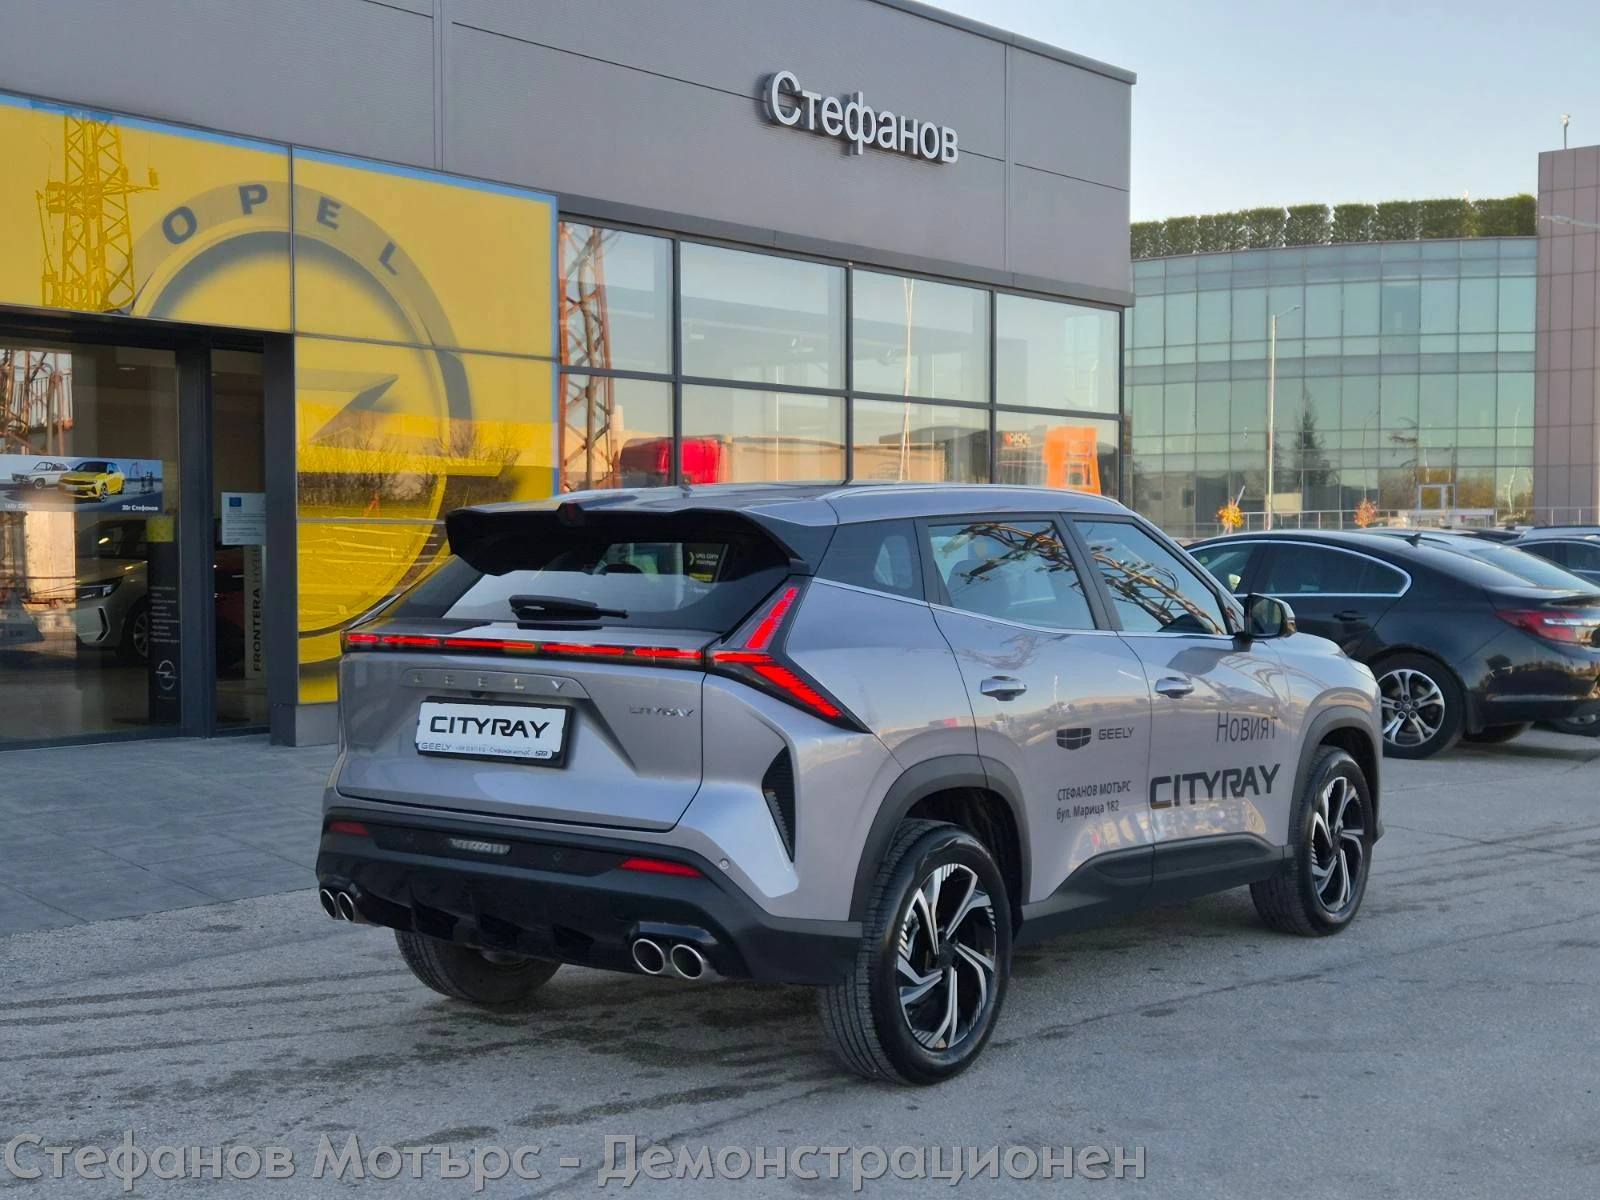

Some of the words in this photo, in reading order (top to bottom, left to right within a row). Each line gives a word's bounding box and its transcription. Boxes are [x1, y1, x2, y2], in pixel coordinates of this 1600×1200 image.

[766, 70, 960, 164] Стефанов
[162, 183, 400, 276] OPEL
[252, 587, 262, 673] FRONTERA
[429, 715, 551, 739] CITYRAY
[1098, 727, 1135, 741] GEELY
[421, 742, 452, 751] GEELY
[1057, 784, 1098, 801] СТЕФАНОВ
[1099, 780, 1132, 796] МОТЪРС
[1149, 763, 1282, 810] CITYRAY
[1056, 807, 1073, 823] бул.
[1073, 802, 1105, 819] Марица
[1106, 800, 1120, 813] 182
